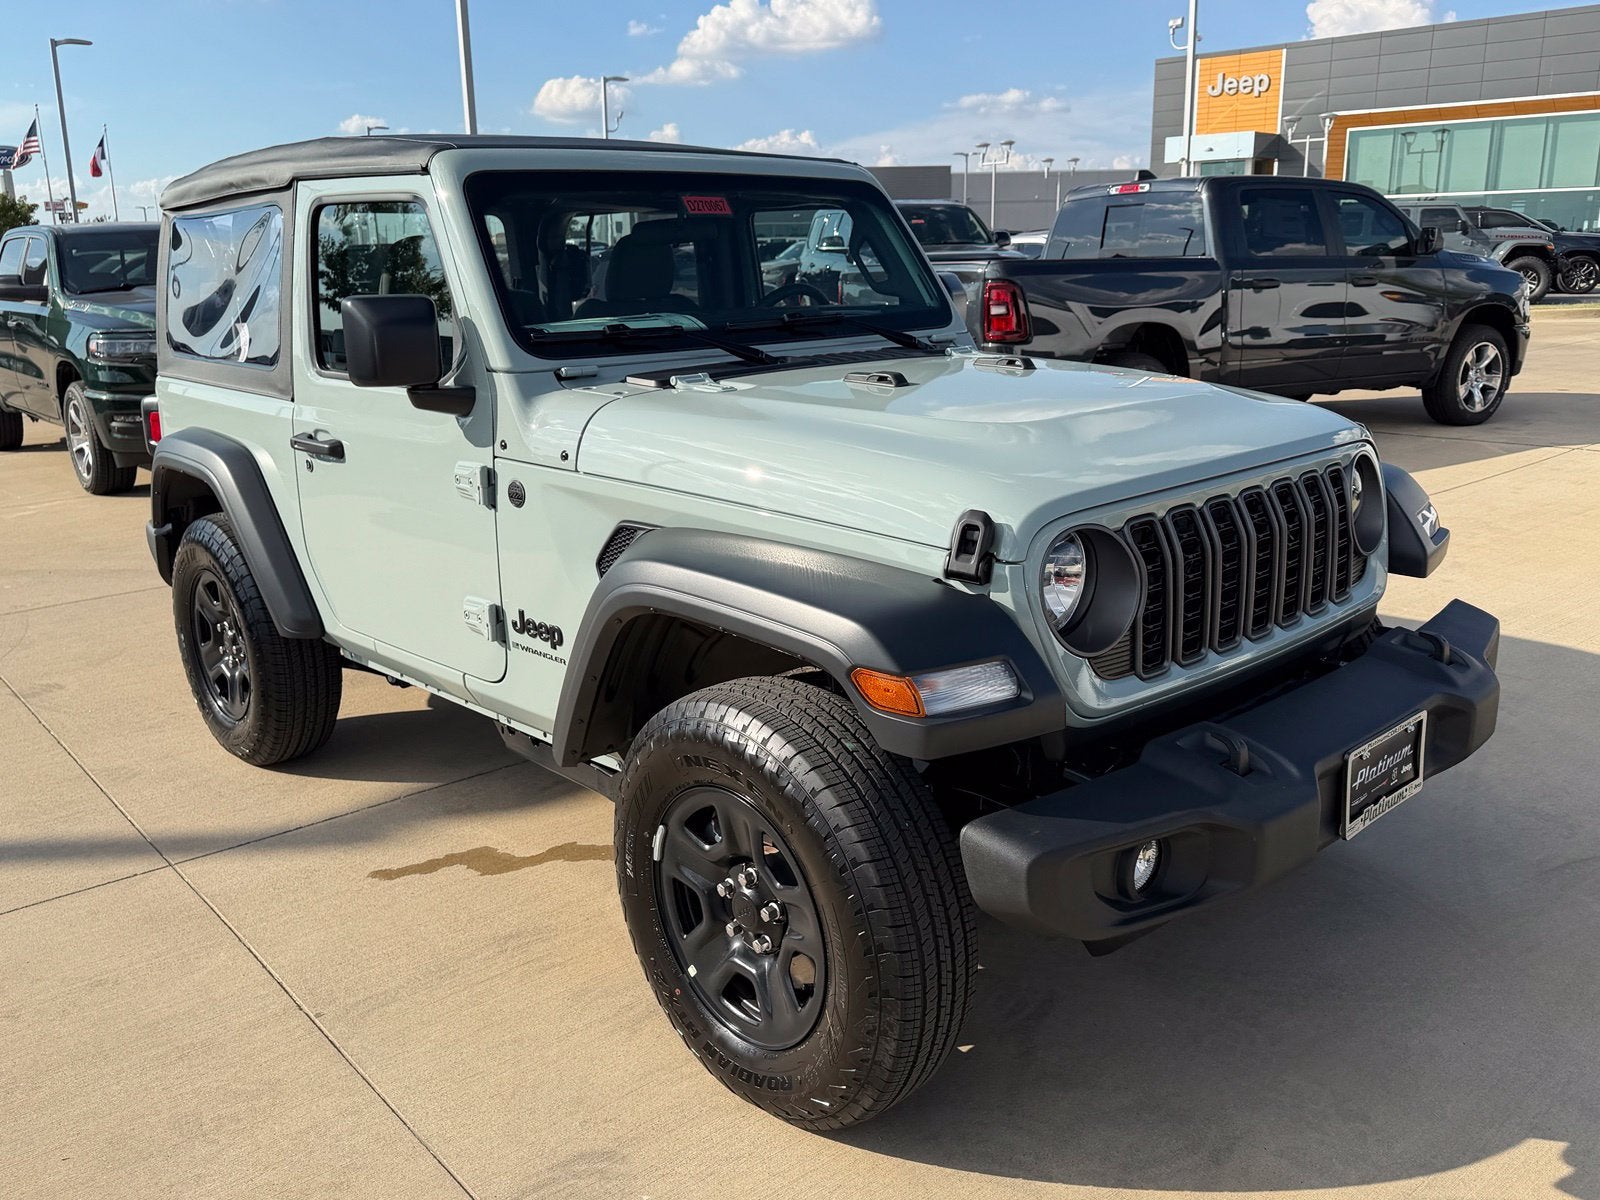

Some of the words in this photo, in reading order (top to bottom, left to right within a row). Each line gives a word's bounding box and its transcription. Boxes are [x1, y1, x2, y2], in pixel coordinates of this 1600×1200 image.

[1207, 72, 1271, 98] Jeep
[511, 608, 564, 650] Jeep
[519, 643, 567, 666] WRANGLER
[1352, 744, 1414, 790] Platinum
[1362, 790, 1407, 827] Platinum
[702, 1039, 793, 1091] ROADIAN
